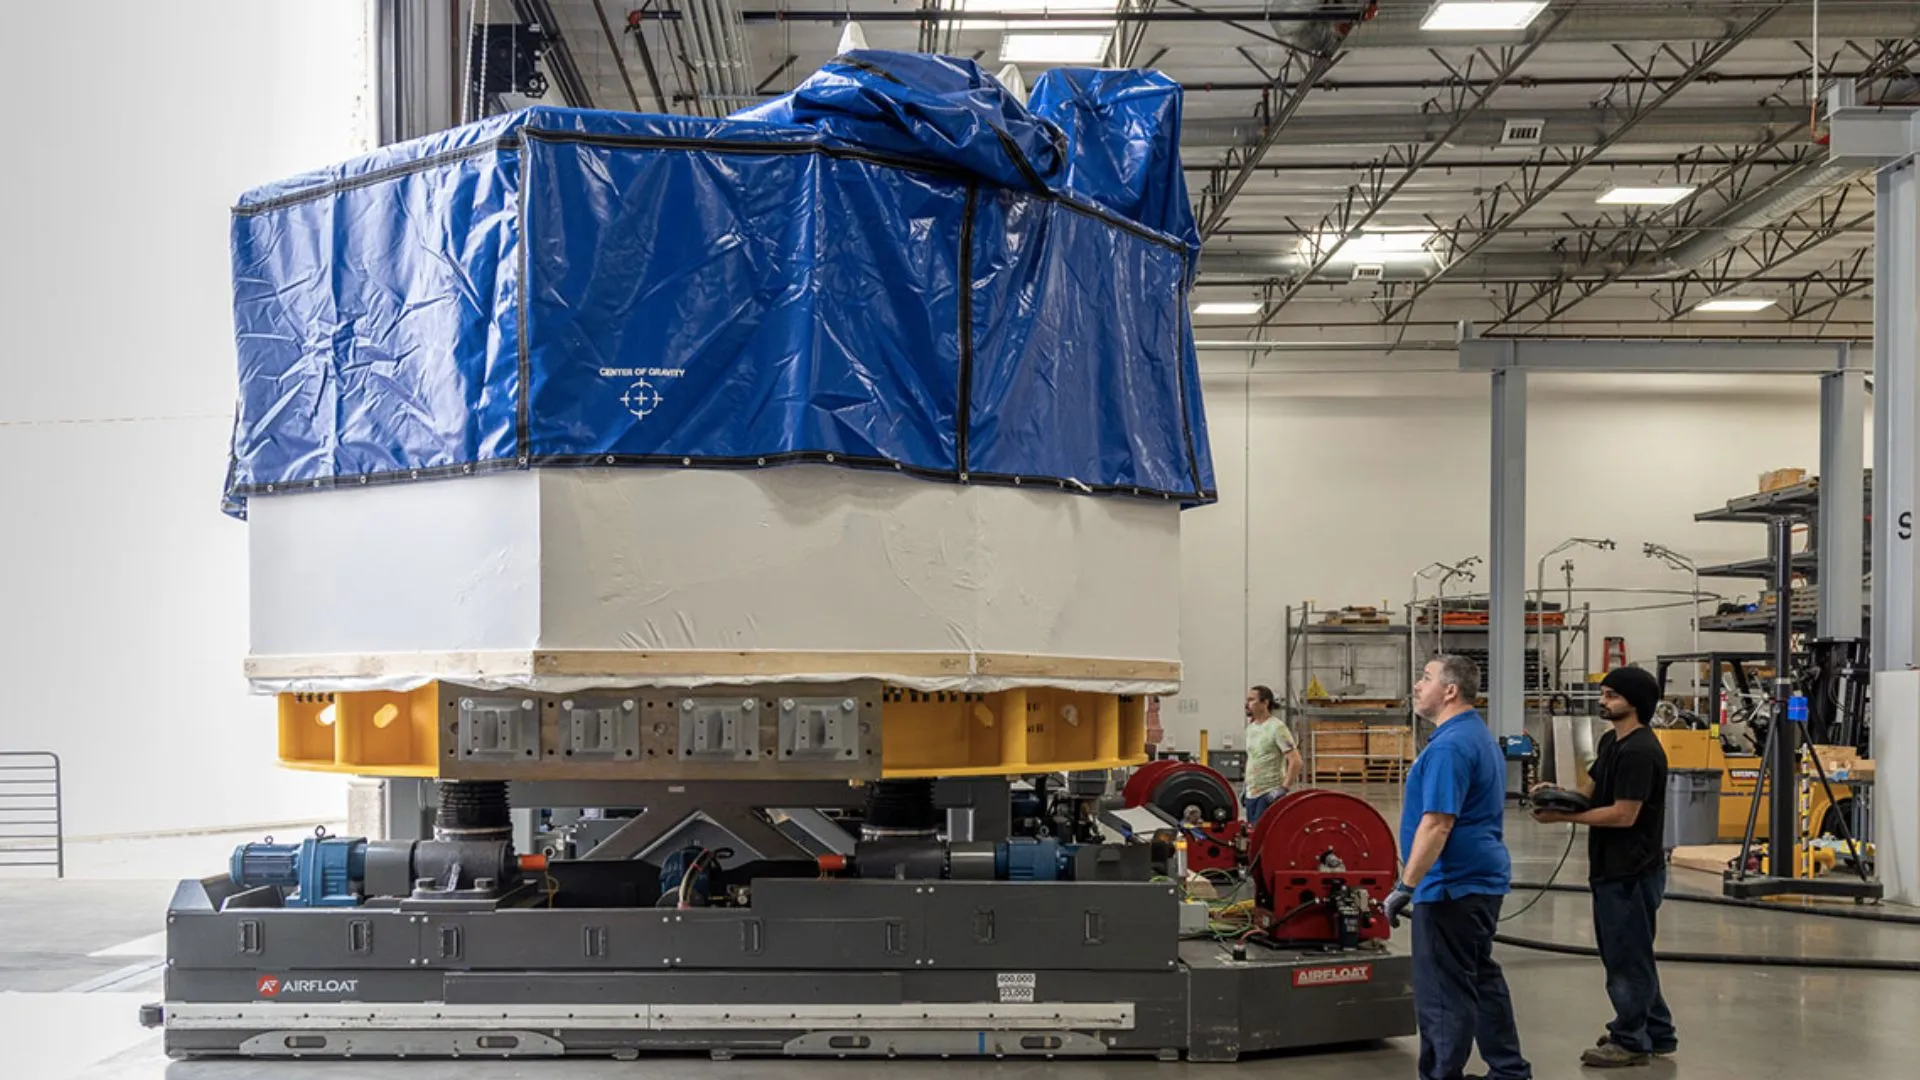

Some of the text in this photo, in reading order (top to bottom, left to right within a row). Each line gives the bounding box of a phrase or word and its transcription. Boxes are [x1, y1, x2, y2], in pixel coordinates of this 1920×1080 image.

[599, 367, 685, 377] CENTER OF GRAVITY
[1297, 966, 1369, 985] AIRFLOAT
[281, 980, 359, 993] AIRFLOAT
